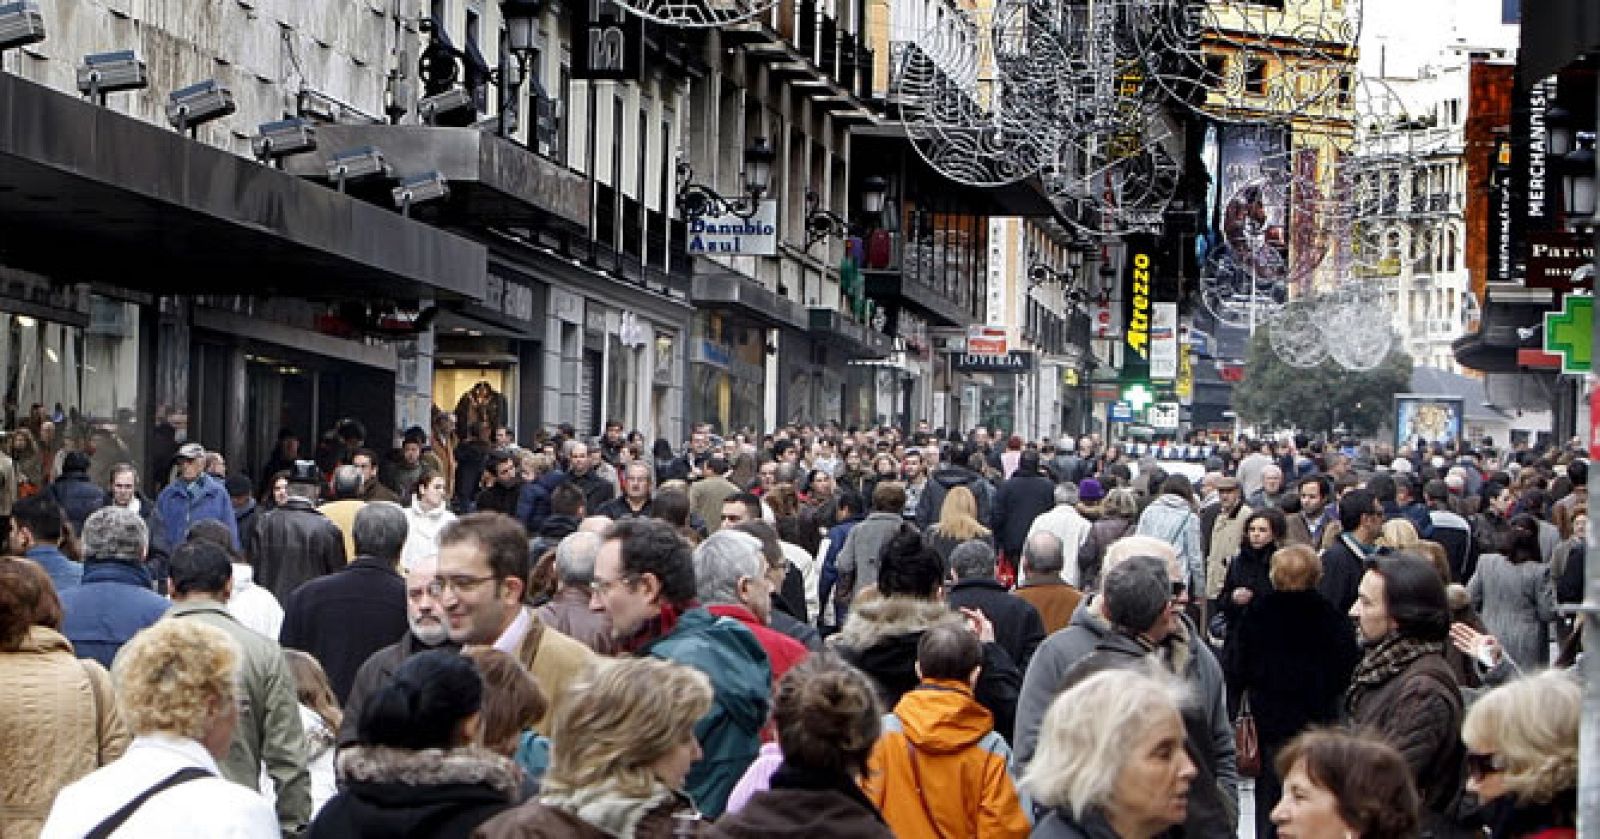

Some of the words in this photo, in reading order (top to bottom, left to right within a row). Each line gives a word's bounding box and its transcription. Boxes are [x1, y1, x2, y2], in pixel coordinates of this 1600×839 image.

[690, 217, 775, 235] Danubio
[689, 235, 741, 252] Azul
[1127, 253, 1150, 361] Atrezzo
